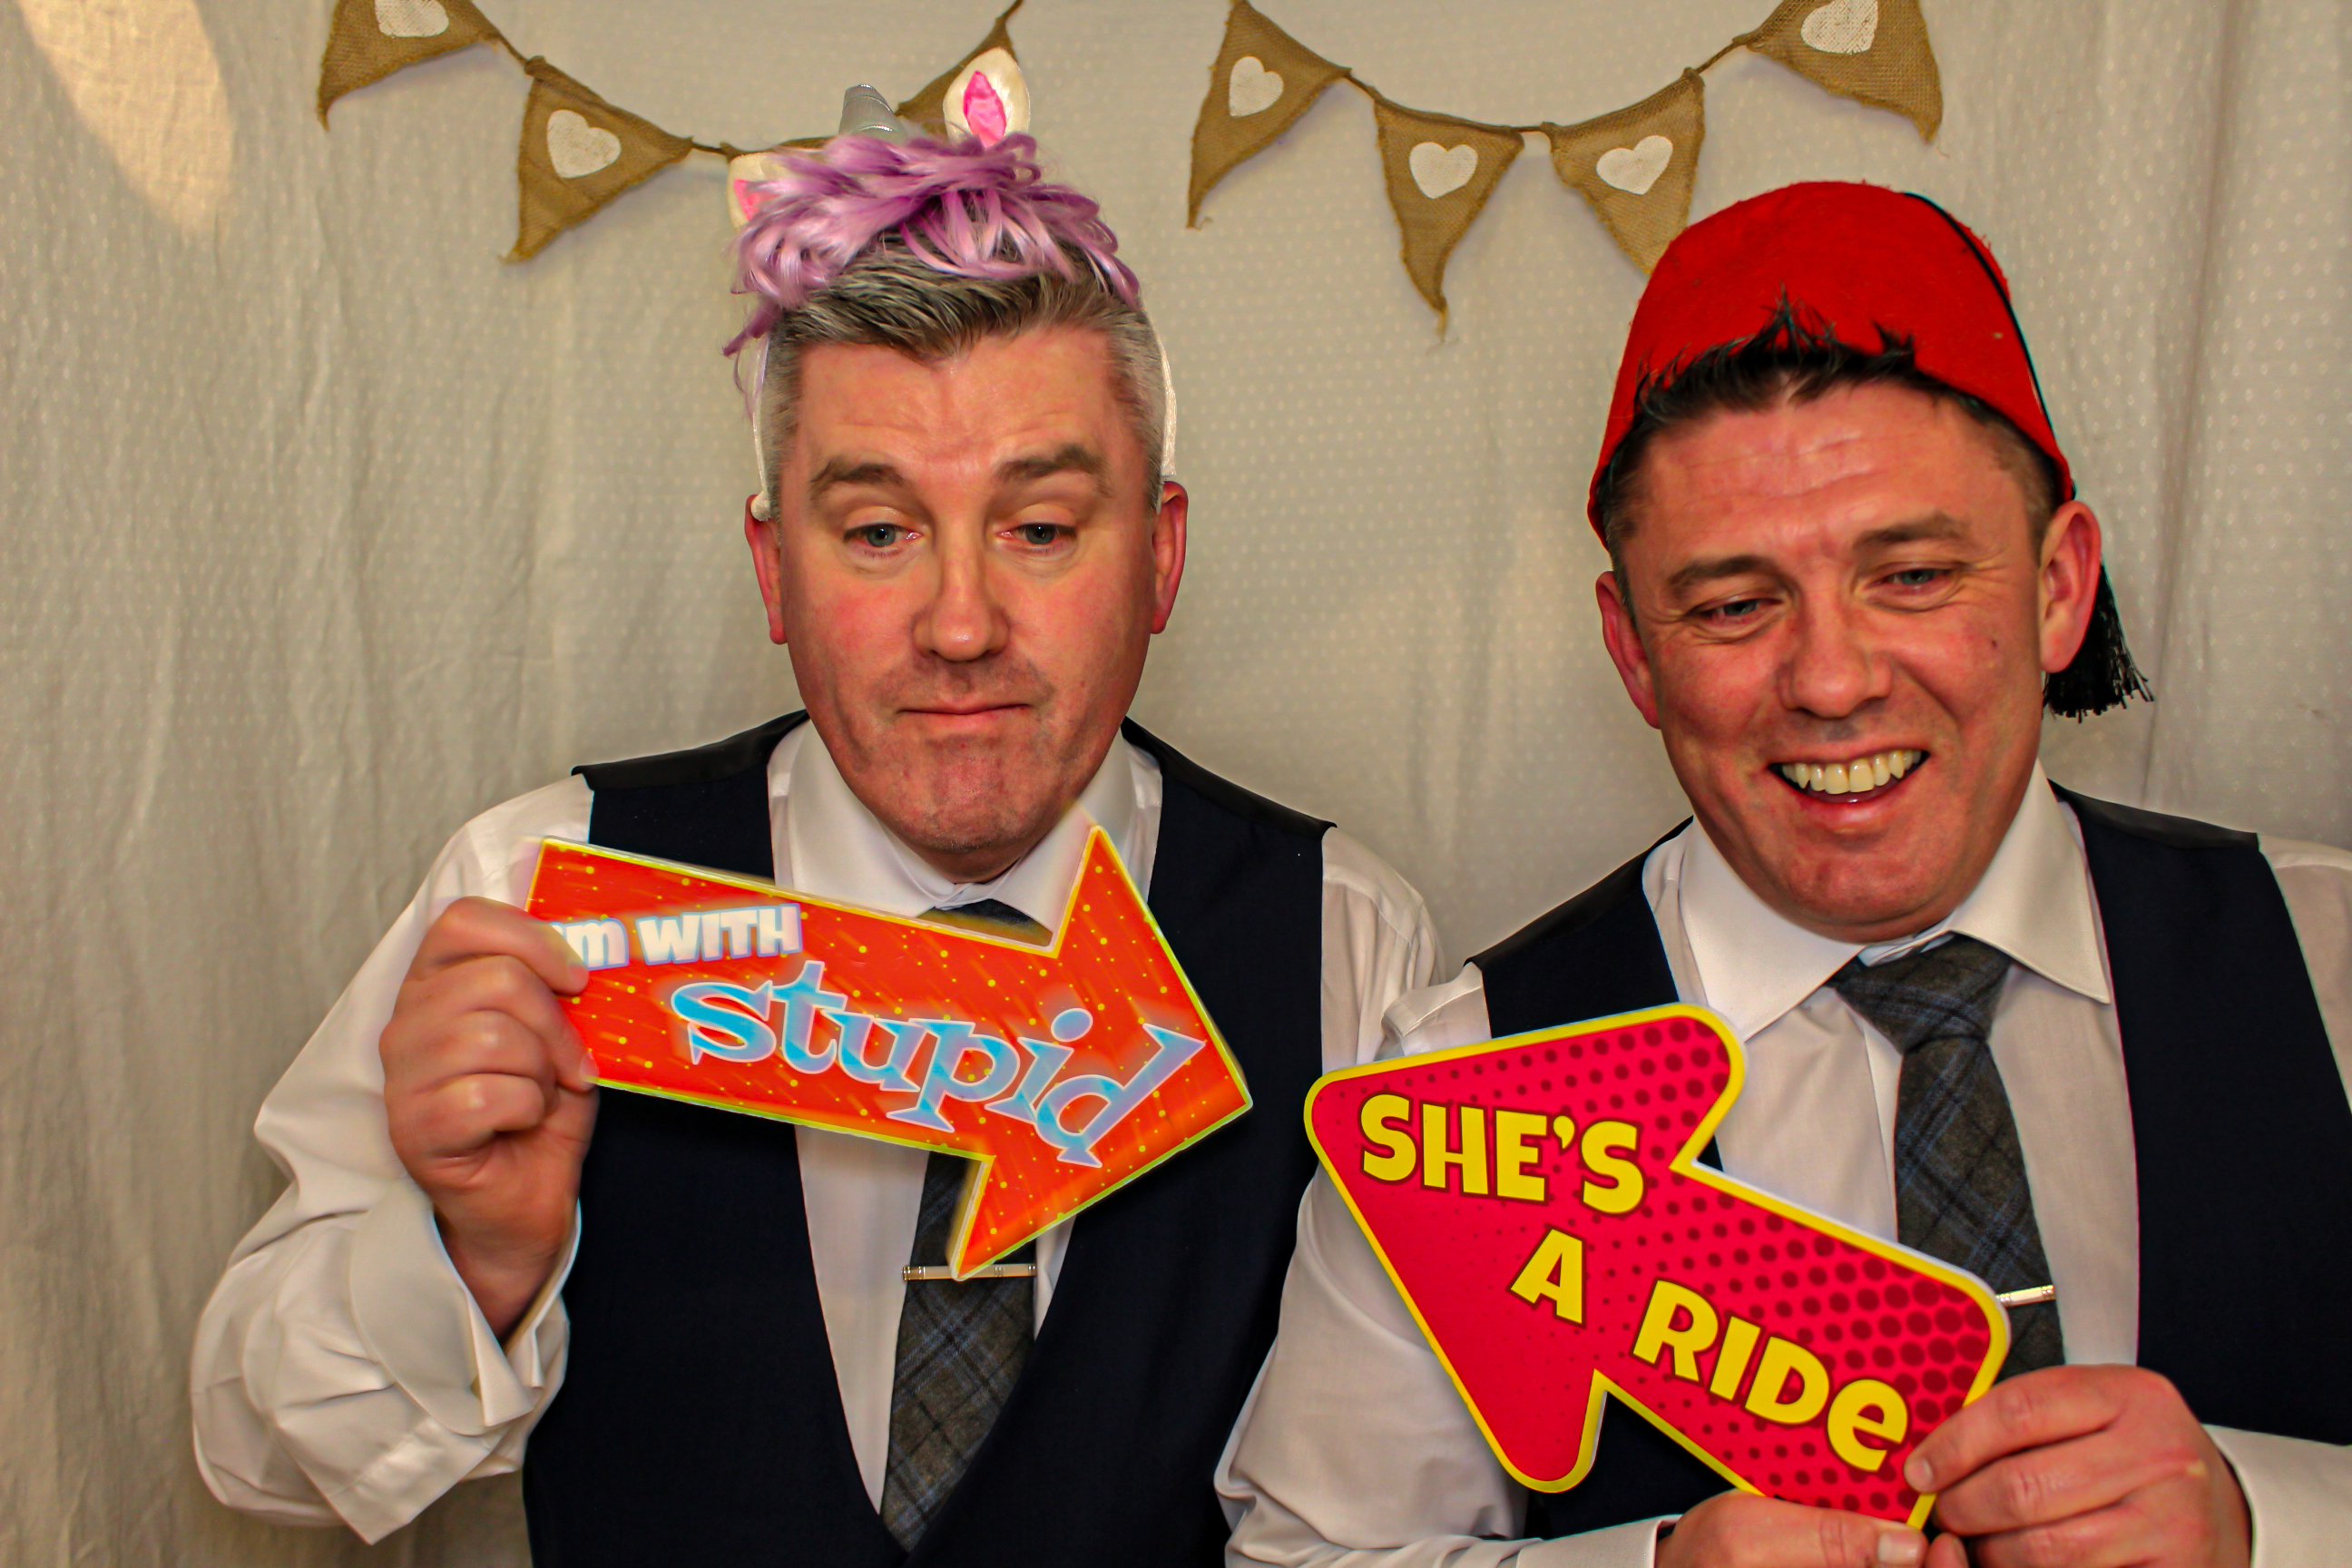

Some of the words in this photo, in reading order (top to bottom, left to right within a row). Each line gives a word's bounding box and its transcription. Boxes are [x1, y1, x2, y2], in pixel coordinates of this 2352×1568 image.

[635, 903, 803, 965] WITH
[1359, 1093, 1645, 1215] SHE'S
[1508, 1227, 1586, 1327] A
